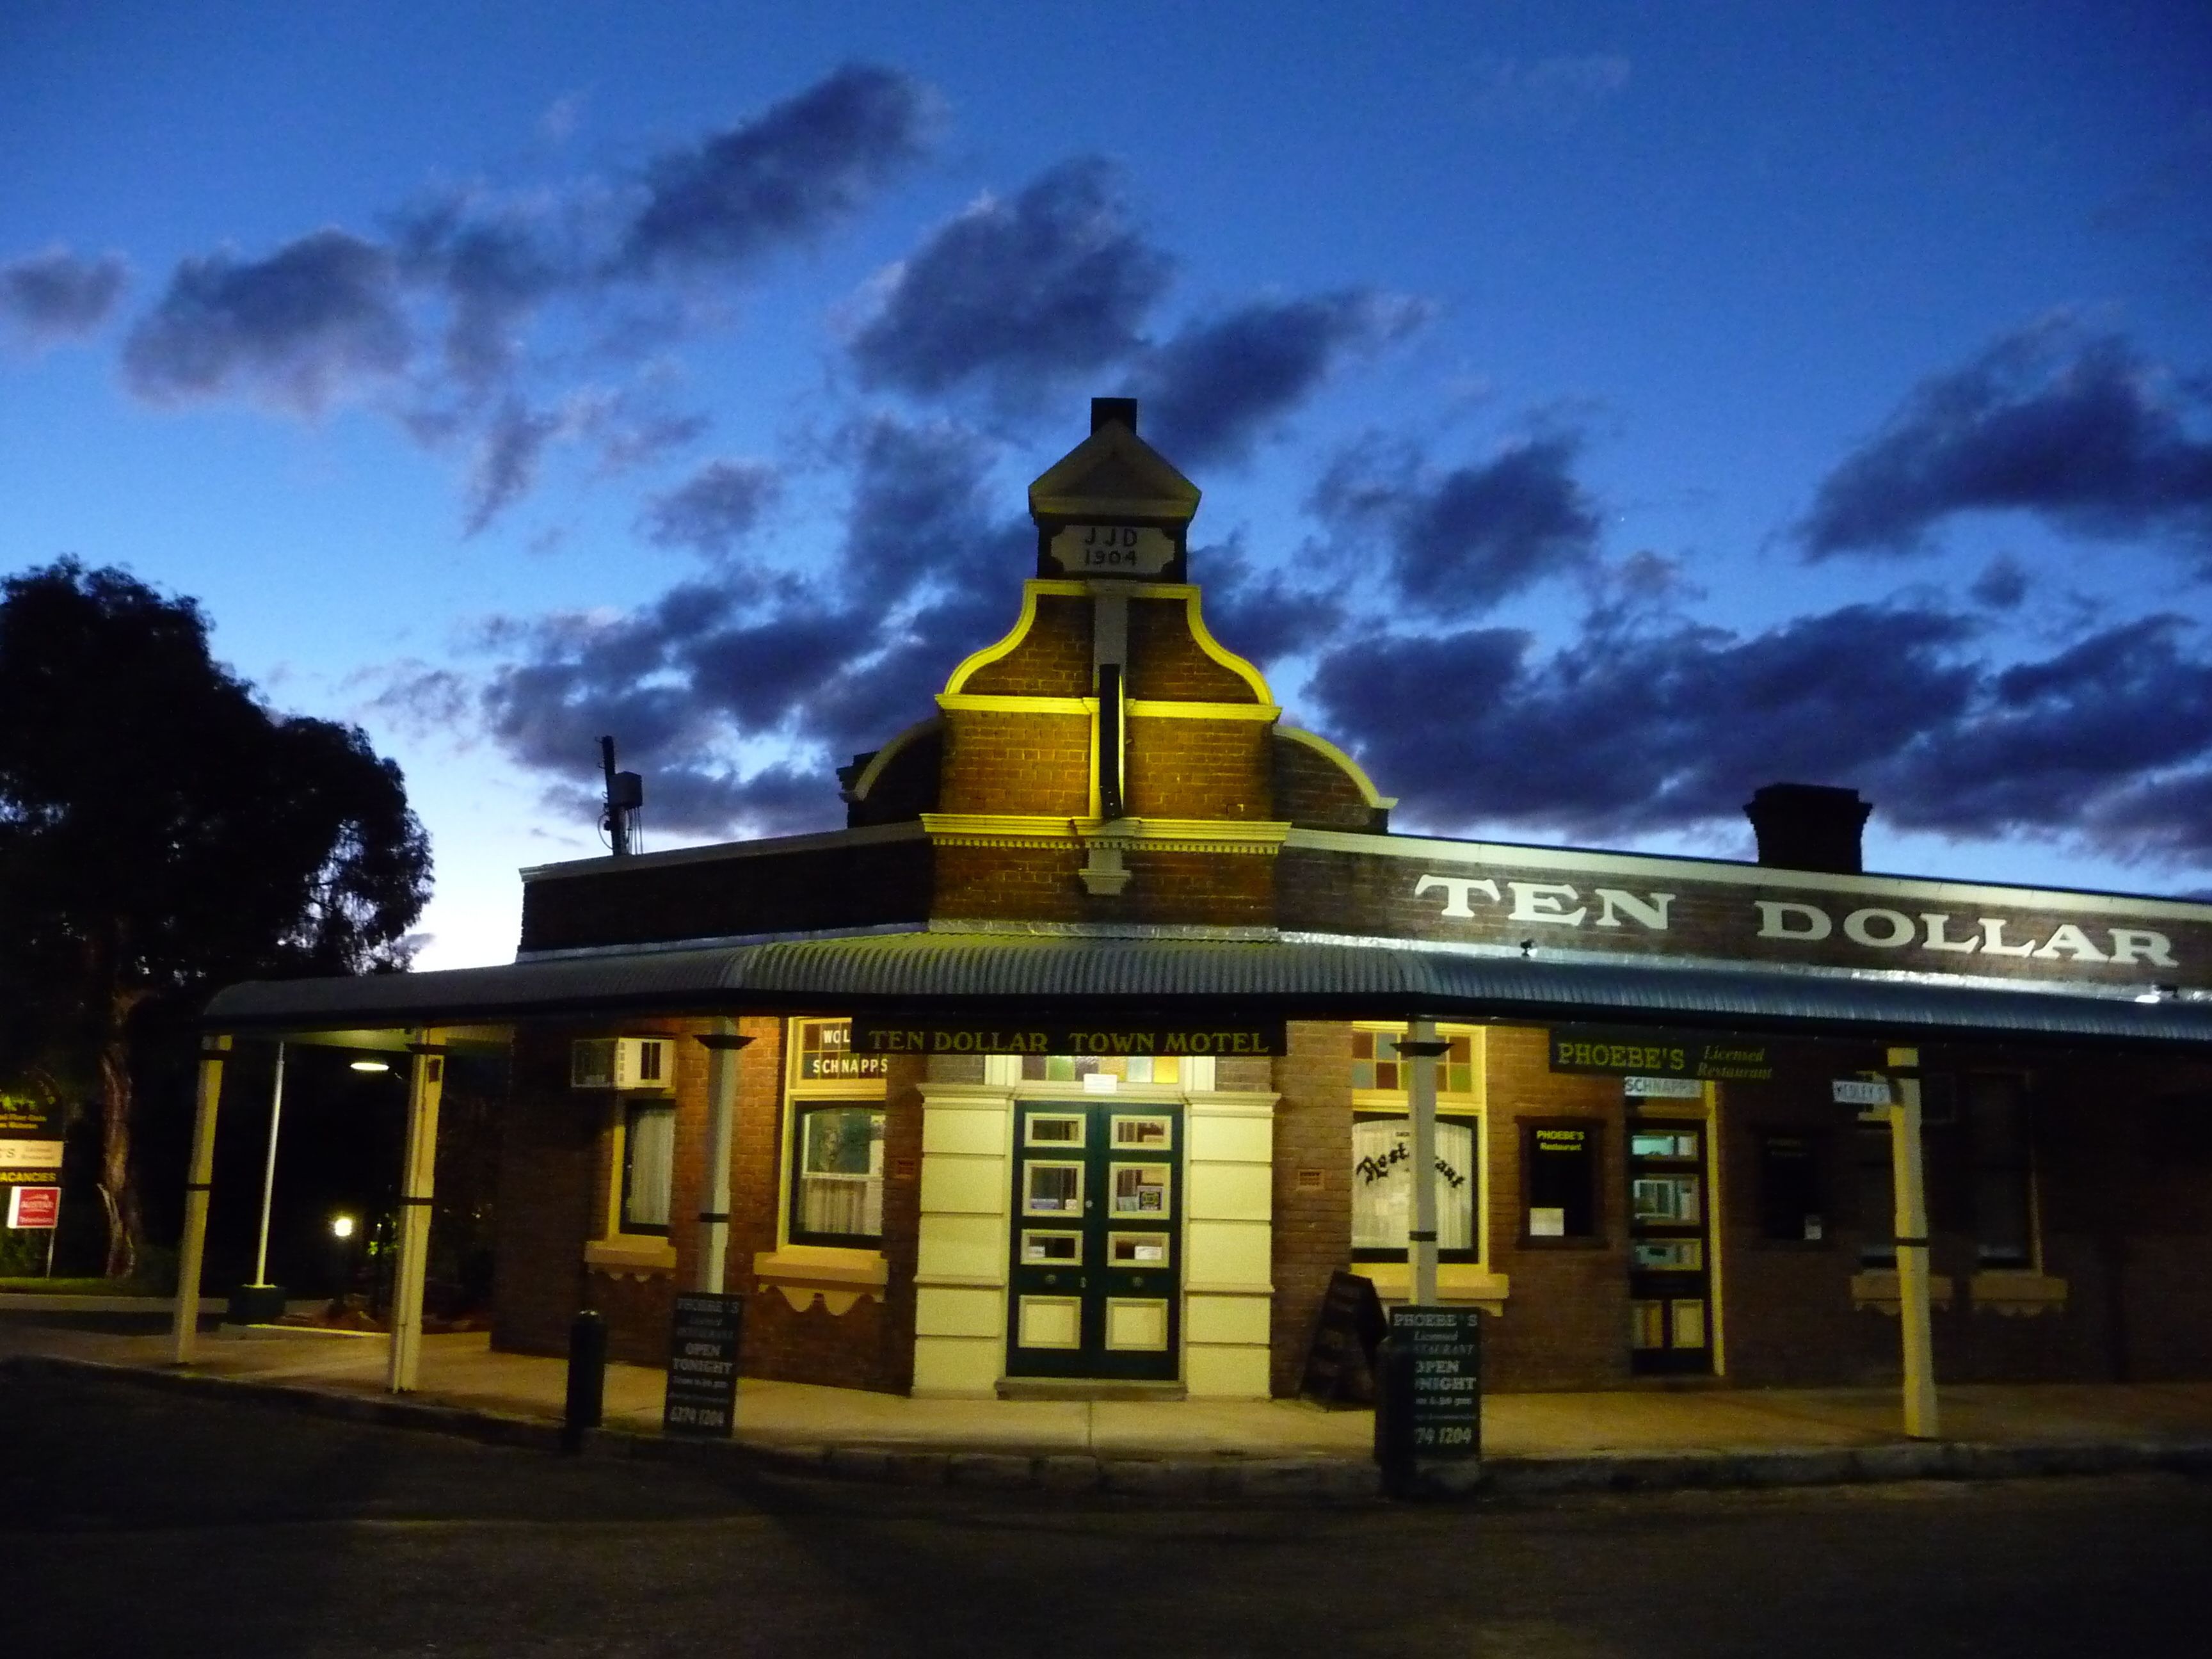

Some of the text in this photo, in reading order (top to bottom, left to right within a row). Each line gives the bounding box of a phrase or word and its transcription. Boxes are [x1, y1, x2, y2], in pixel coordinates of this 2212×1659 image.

[1086, 549, 1137, 566] 1904
[1414, 874, 2179, 967] TEN DOLLAR
[823, 1029, 851, 1044] WOL
[868, 1030, 1270, 1054] TEN DOLLAR TOWN MOTEL
[1557, 1042, 1685, 1071] PHOEBE'S
[812, 1058, 888, 1074] SCHNAPPS
[0, 1172, 56, 1183] ACANCIES
[1393, 1313, 1478, 1327] PHOEBE'S
